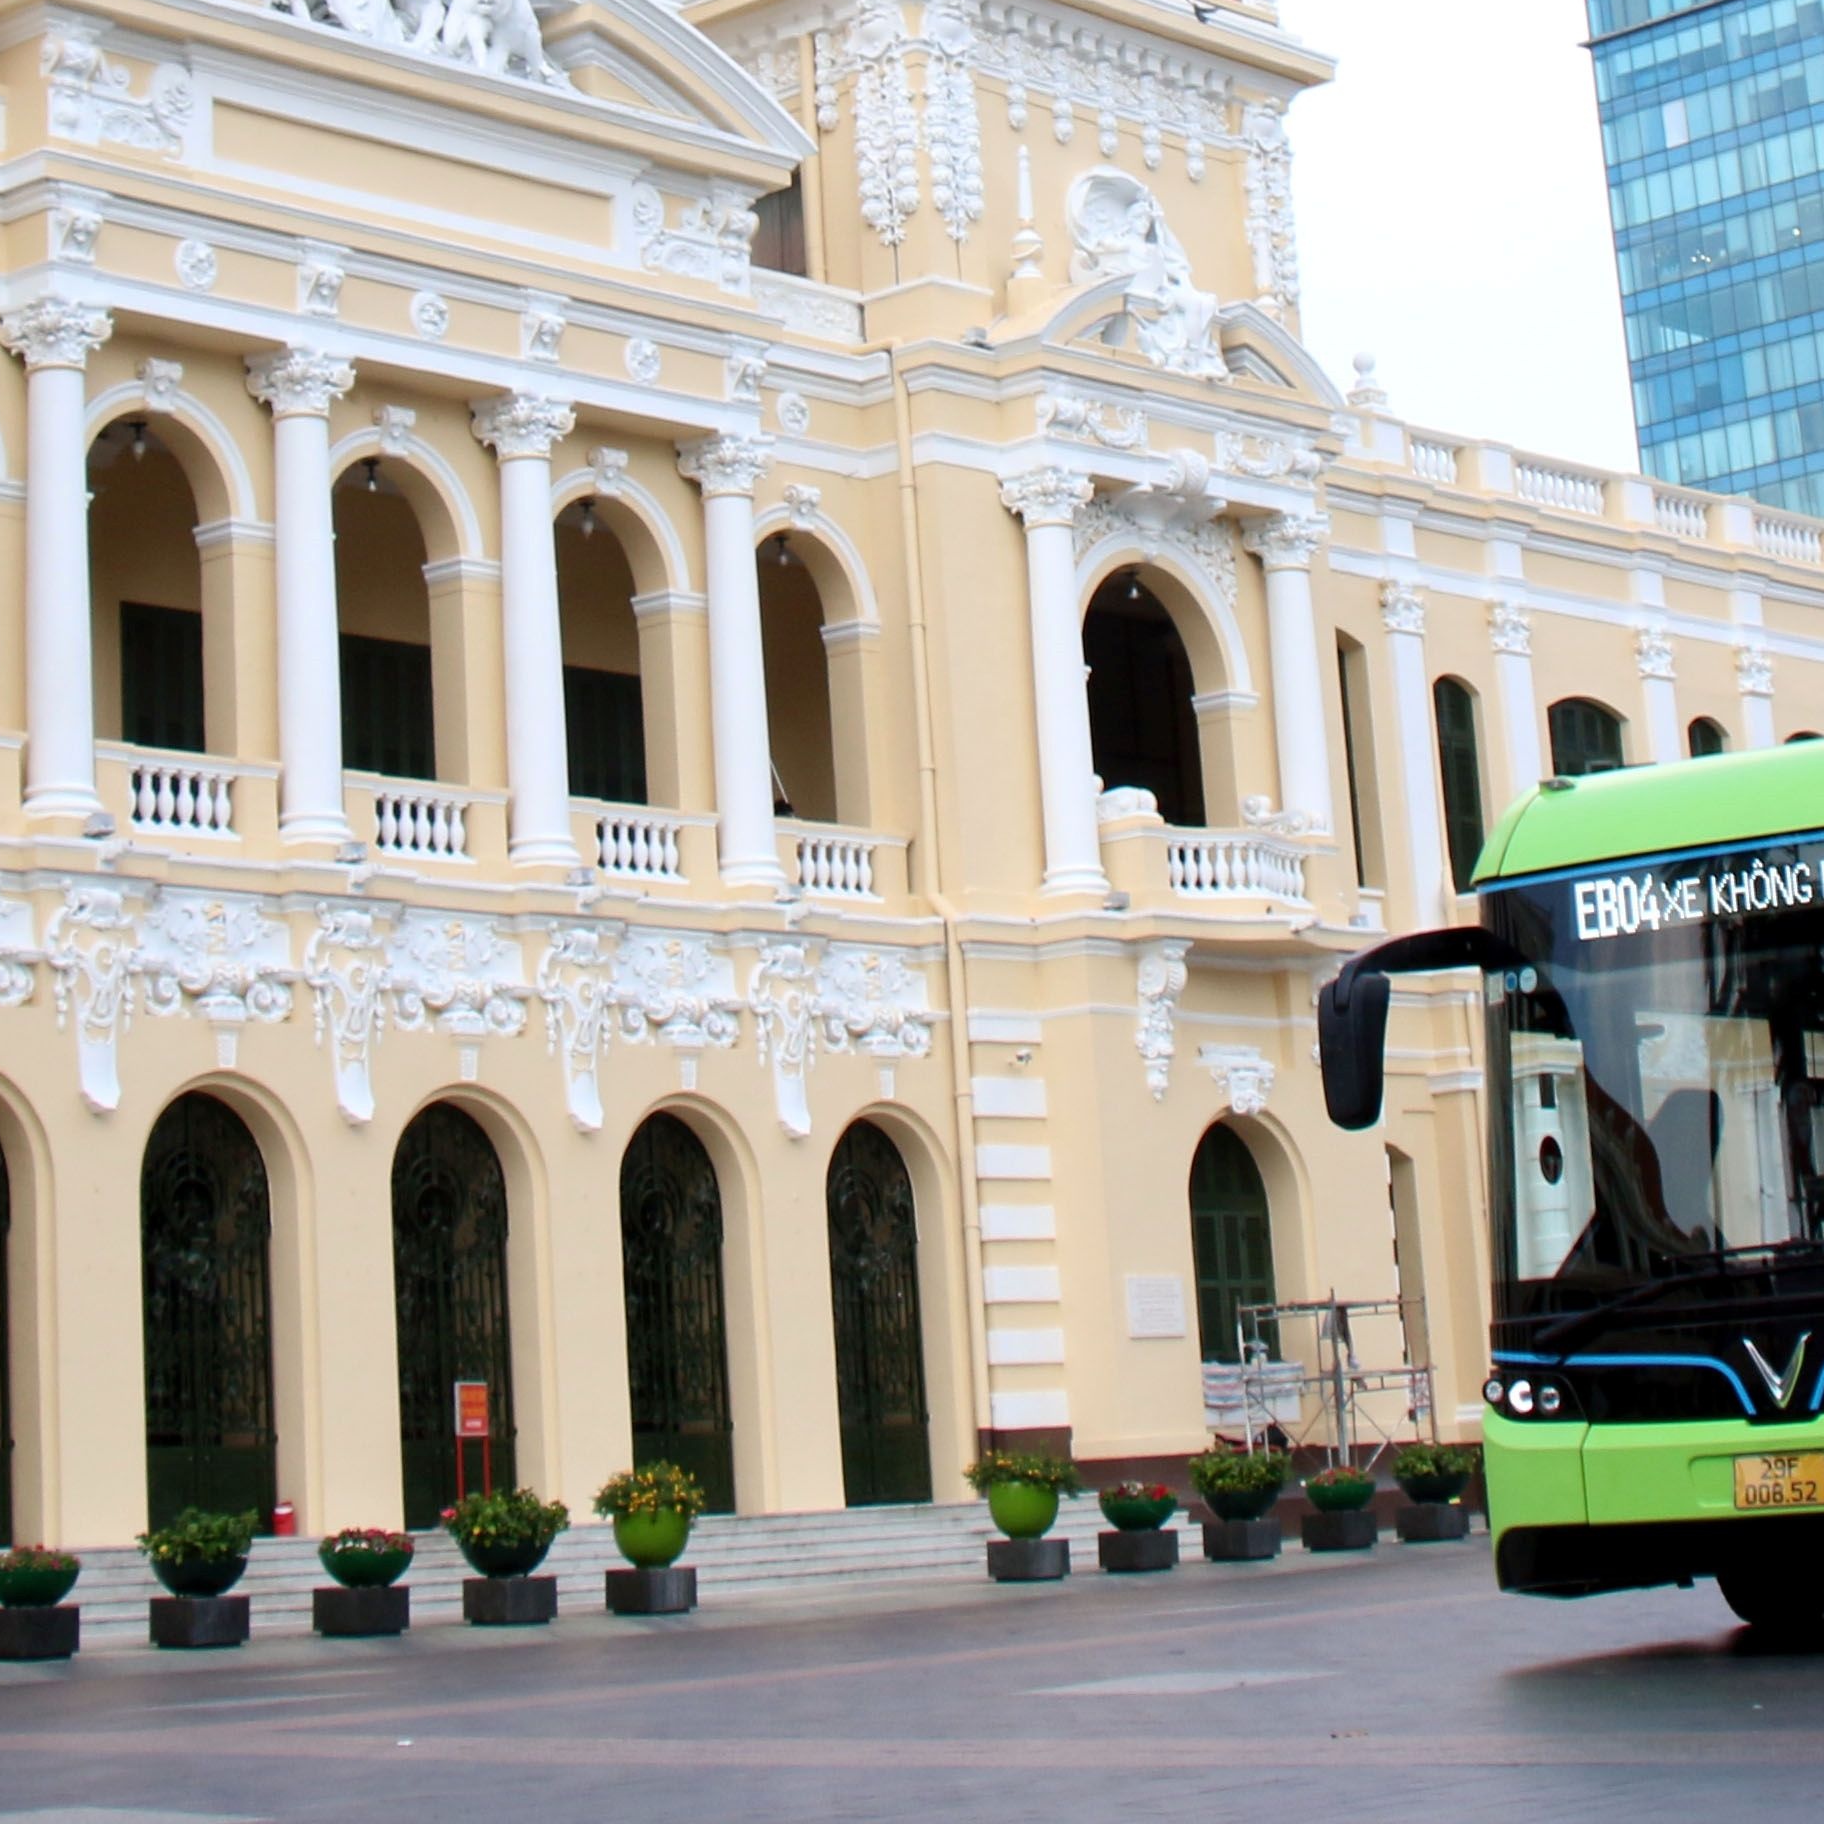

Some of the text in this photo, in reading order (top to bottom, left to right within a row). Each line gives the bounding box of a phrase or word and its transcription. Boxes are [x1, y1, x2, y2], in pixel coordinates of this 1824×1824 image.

[1575, 873, 1660, 941] EB04
[1660, 877, 1705, 922] XE
[1712, 857, 1813, 916] KHÔNG
[1760, 1456, 1800, 1480] 29F
